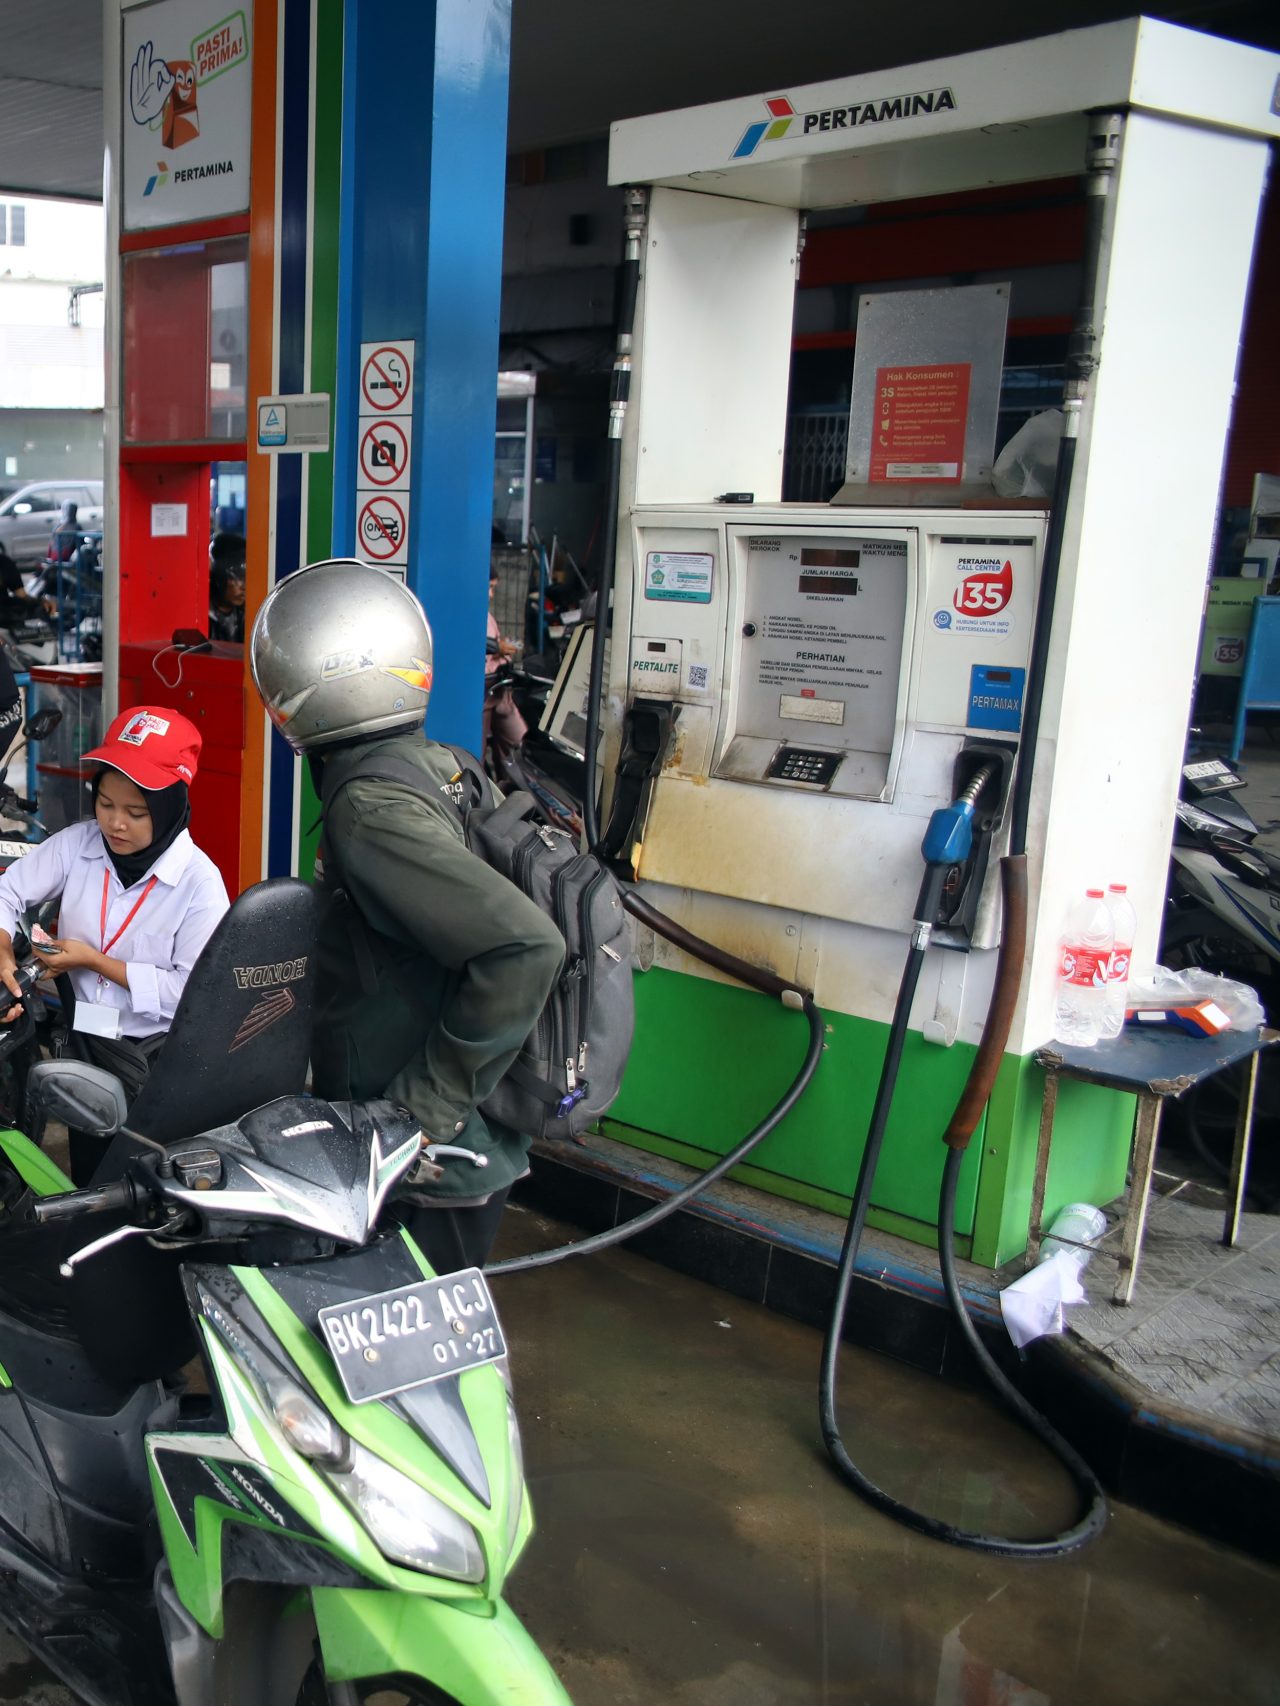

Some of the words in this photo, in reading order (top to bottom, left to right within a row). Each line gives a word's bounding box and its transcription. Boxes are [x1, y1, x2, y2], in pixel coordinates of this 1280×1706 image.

[197, 27, 230, 61] PASTI
[199, 37, 243, 77] PRIMA!
[803, 90, 955, 134] PERTAMINA
[174, 160, 234, 184] PERTAMINA
[886, 372, 904, 381] Hak
[906, 370, 954, 381] Konsumen
[366, 522, 381, 532] ON
[955, 582, 1004, 610] 135
[633, 660, 679, 673] PERTALITE
[796, 652, 845, 663] PERHATIAN
[972, 695, 1019, 711] PERTAMAX
[233, 956, 308, 989] HONDA
[232, 1466, 286, 1527] HONDA
